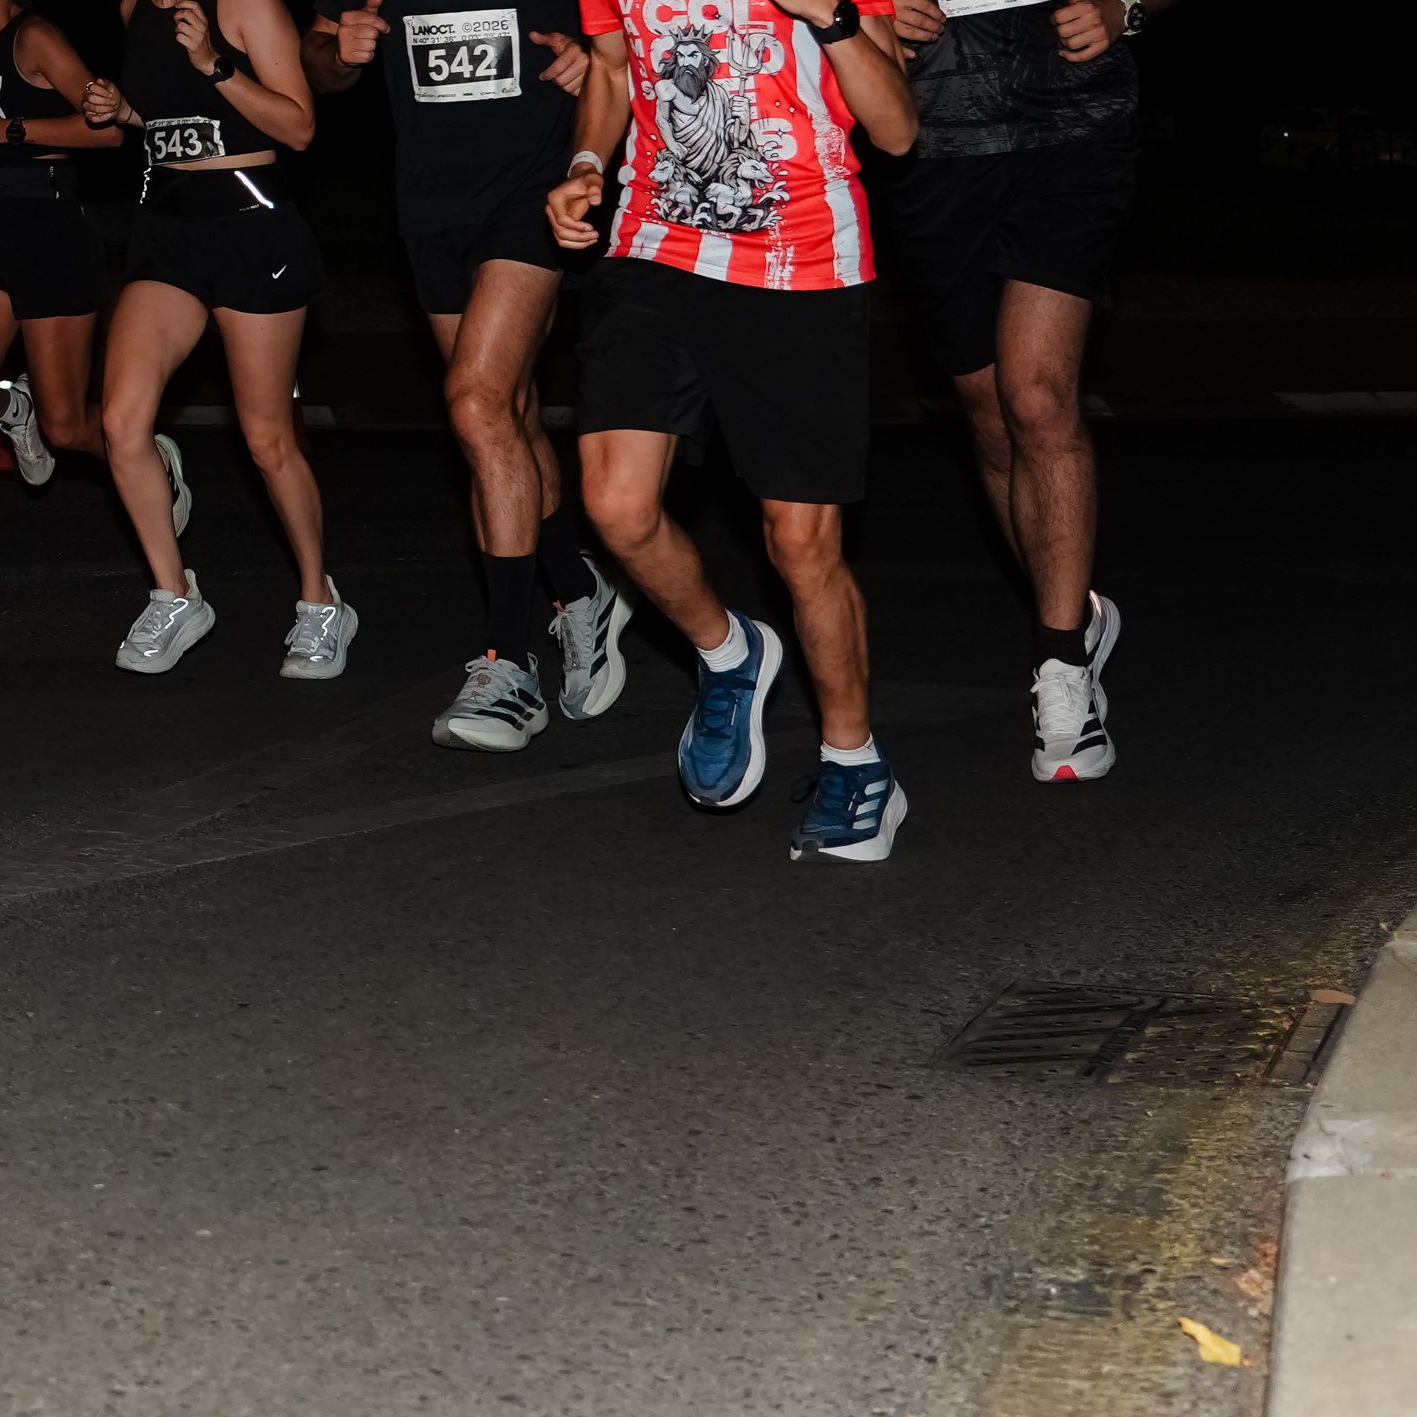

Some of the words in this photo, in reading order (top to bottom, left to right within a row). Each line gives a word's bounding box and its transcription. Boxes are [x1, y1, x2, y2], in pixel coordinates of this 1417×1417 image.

[412, 24, 455, 35] LANOCT.
[461, 19, 509, 33] ©2026
[428, 44, 497, 81] 542
[154, 128, 202, 160] 543
